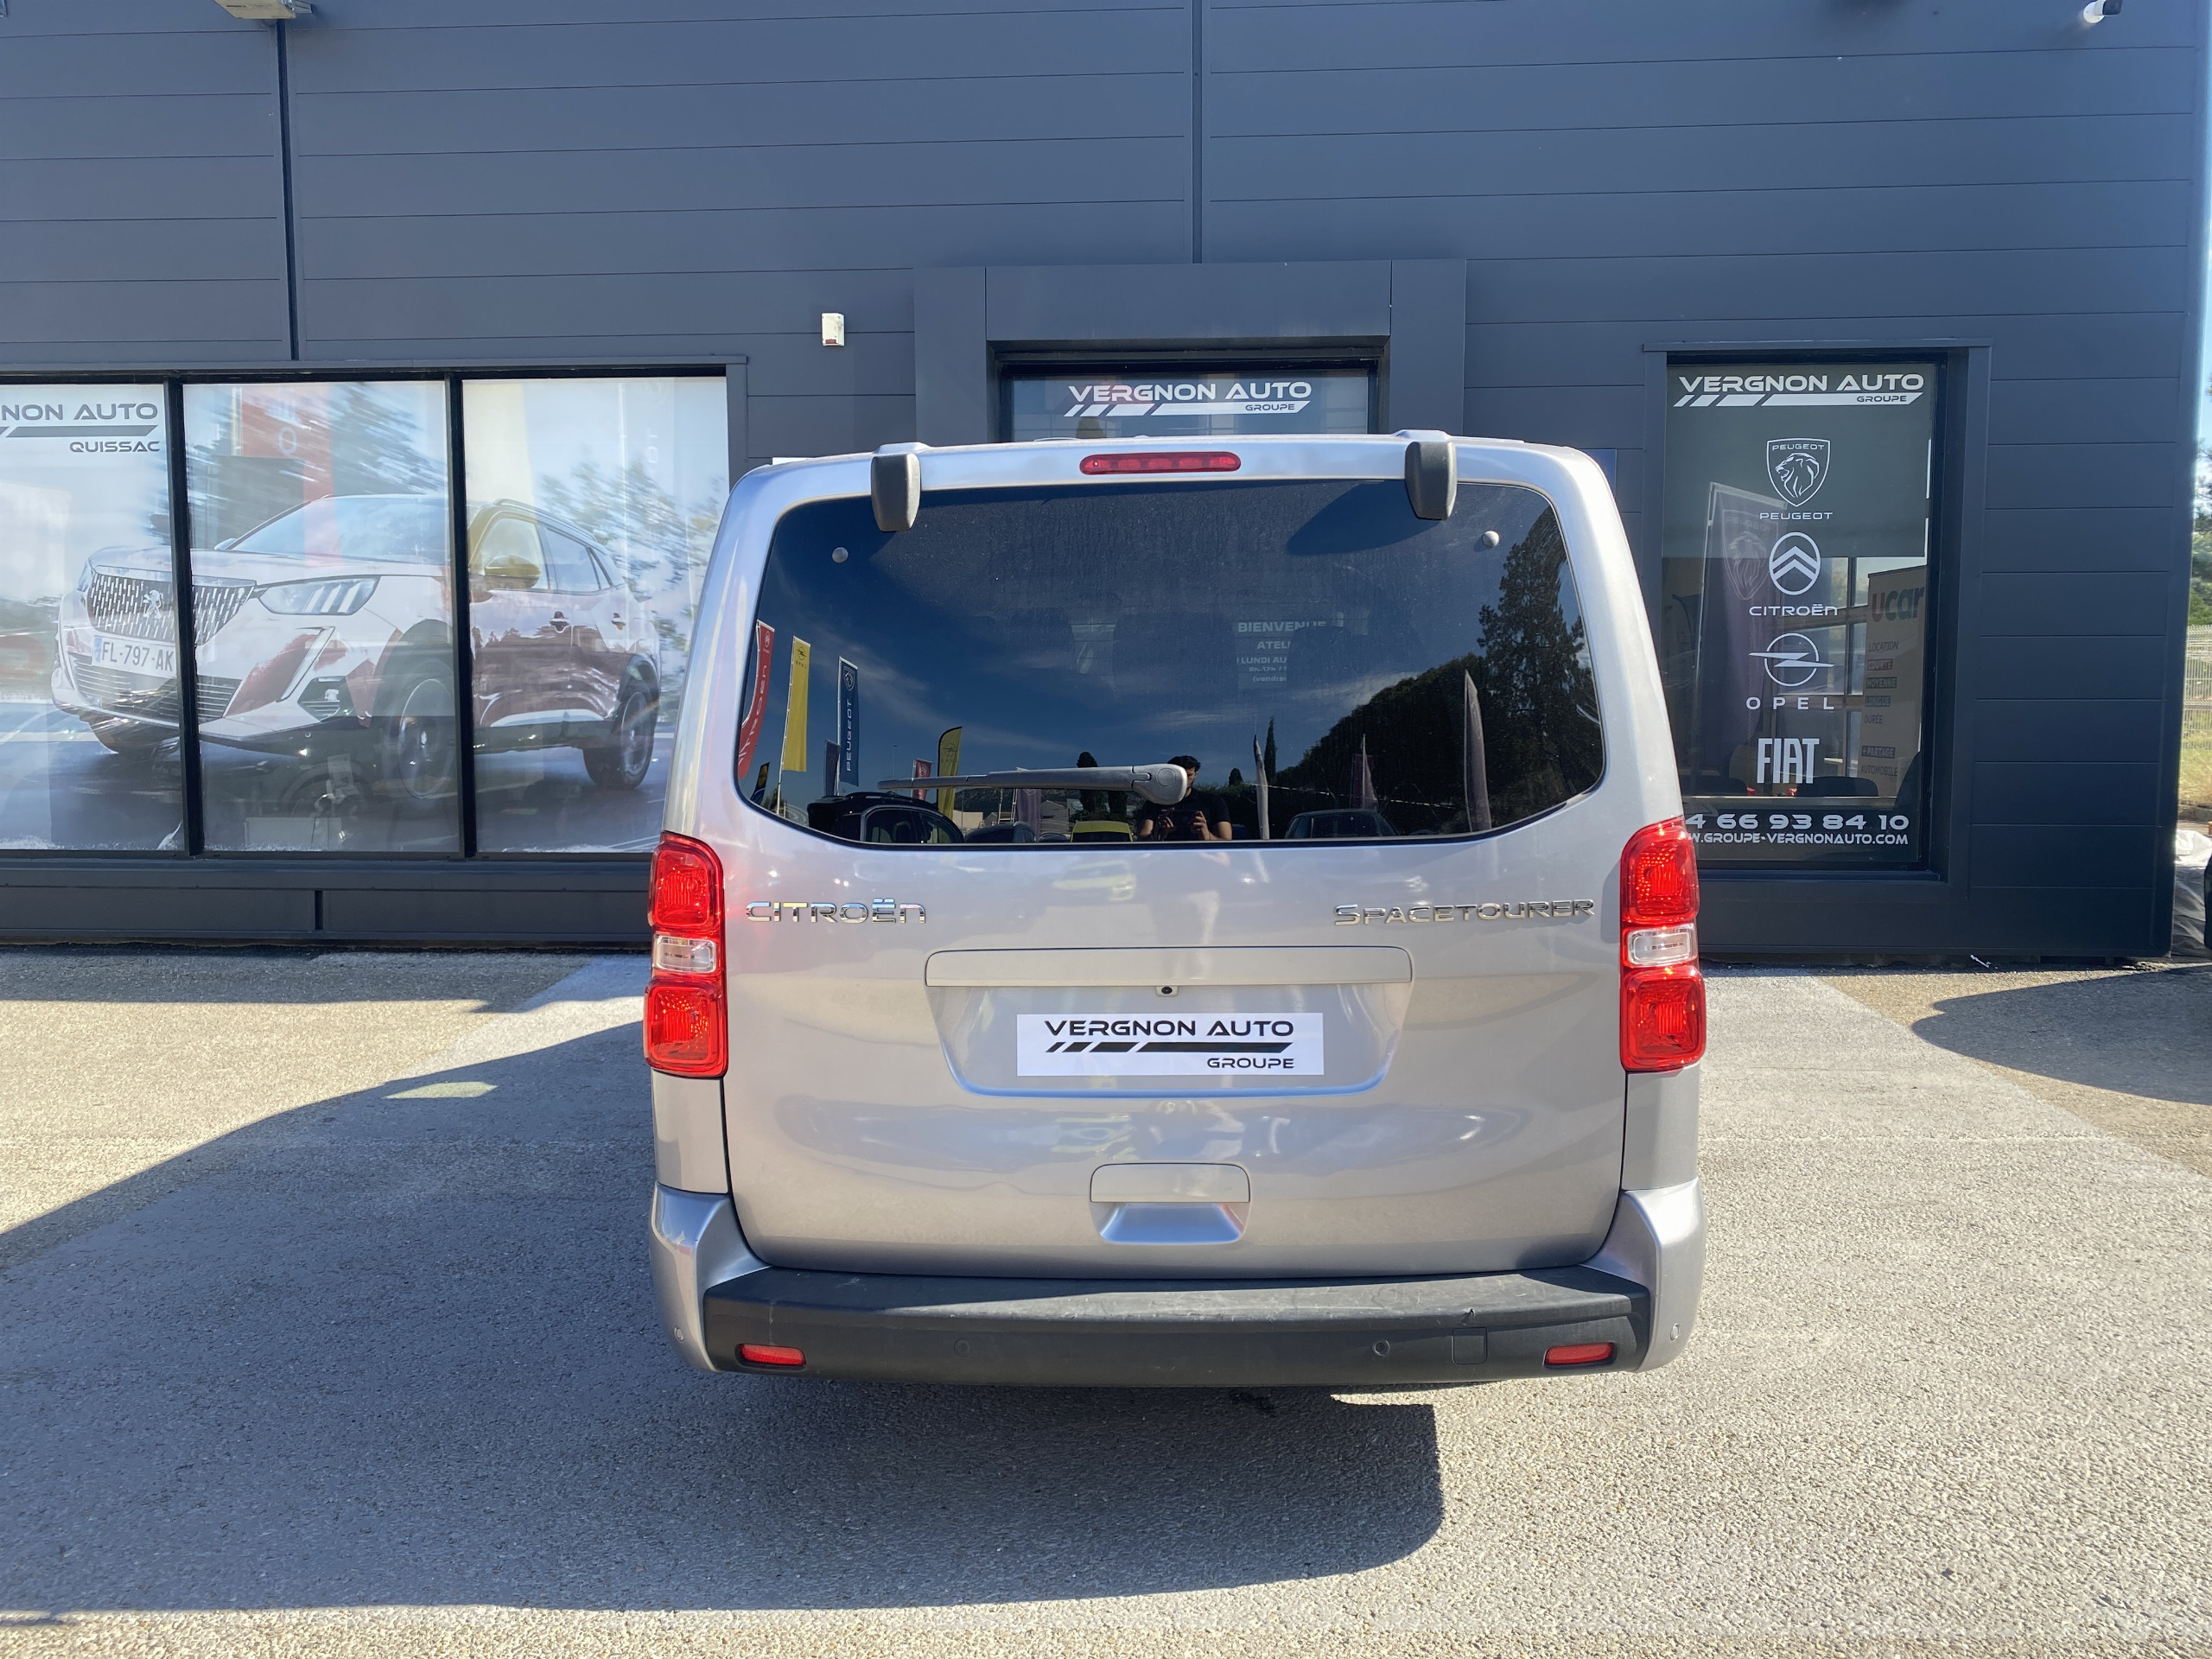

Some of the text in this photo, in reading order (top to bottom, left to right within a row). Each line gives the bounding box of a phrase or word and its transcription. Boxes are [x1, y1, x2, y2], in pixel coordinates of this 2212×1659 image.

[1679, 373, 1925, 392] VERGNON AUTO
[1068, 381, 1312, 402] VERGNON AUTO
[1, 403, 159, 421] NON AUTO
[1245, 403, 1295, 411] GROUPE
[69, 441, 161, 453] QUISSAC
[1759, 512, 1834, 520] PEUGEOT
[1872, 586, 1925, 623] ucar
[1869, 640, 1899, 652] LOCATION
[101, 641, 175, 672] FL-797-AK
[1867, 659, 1893, 670] COURTE
[1866, 677, 1897, 689] MOYENNE
[1745, 696, 1834, 710] OPEL
[1866, 696, 1891, 707] LONGUE
[1864, 714, 1883, 725] DURÉE
[1756, 738, 1820, 784] FIAT
[1860, 765, 1898, 777] AUTOMOBILE
[1684, 813, 1910, 830] 4 66 93 84 10
[1688, 832, 1909, 845] W.GROUPE-VERGNONAUTO.COM
[1044, 1020, 1294, 1037] VERGNON AUTO
[1206, 1057, 1295, 1069] GROUPE
